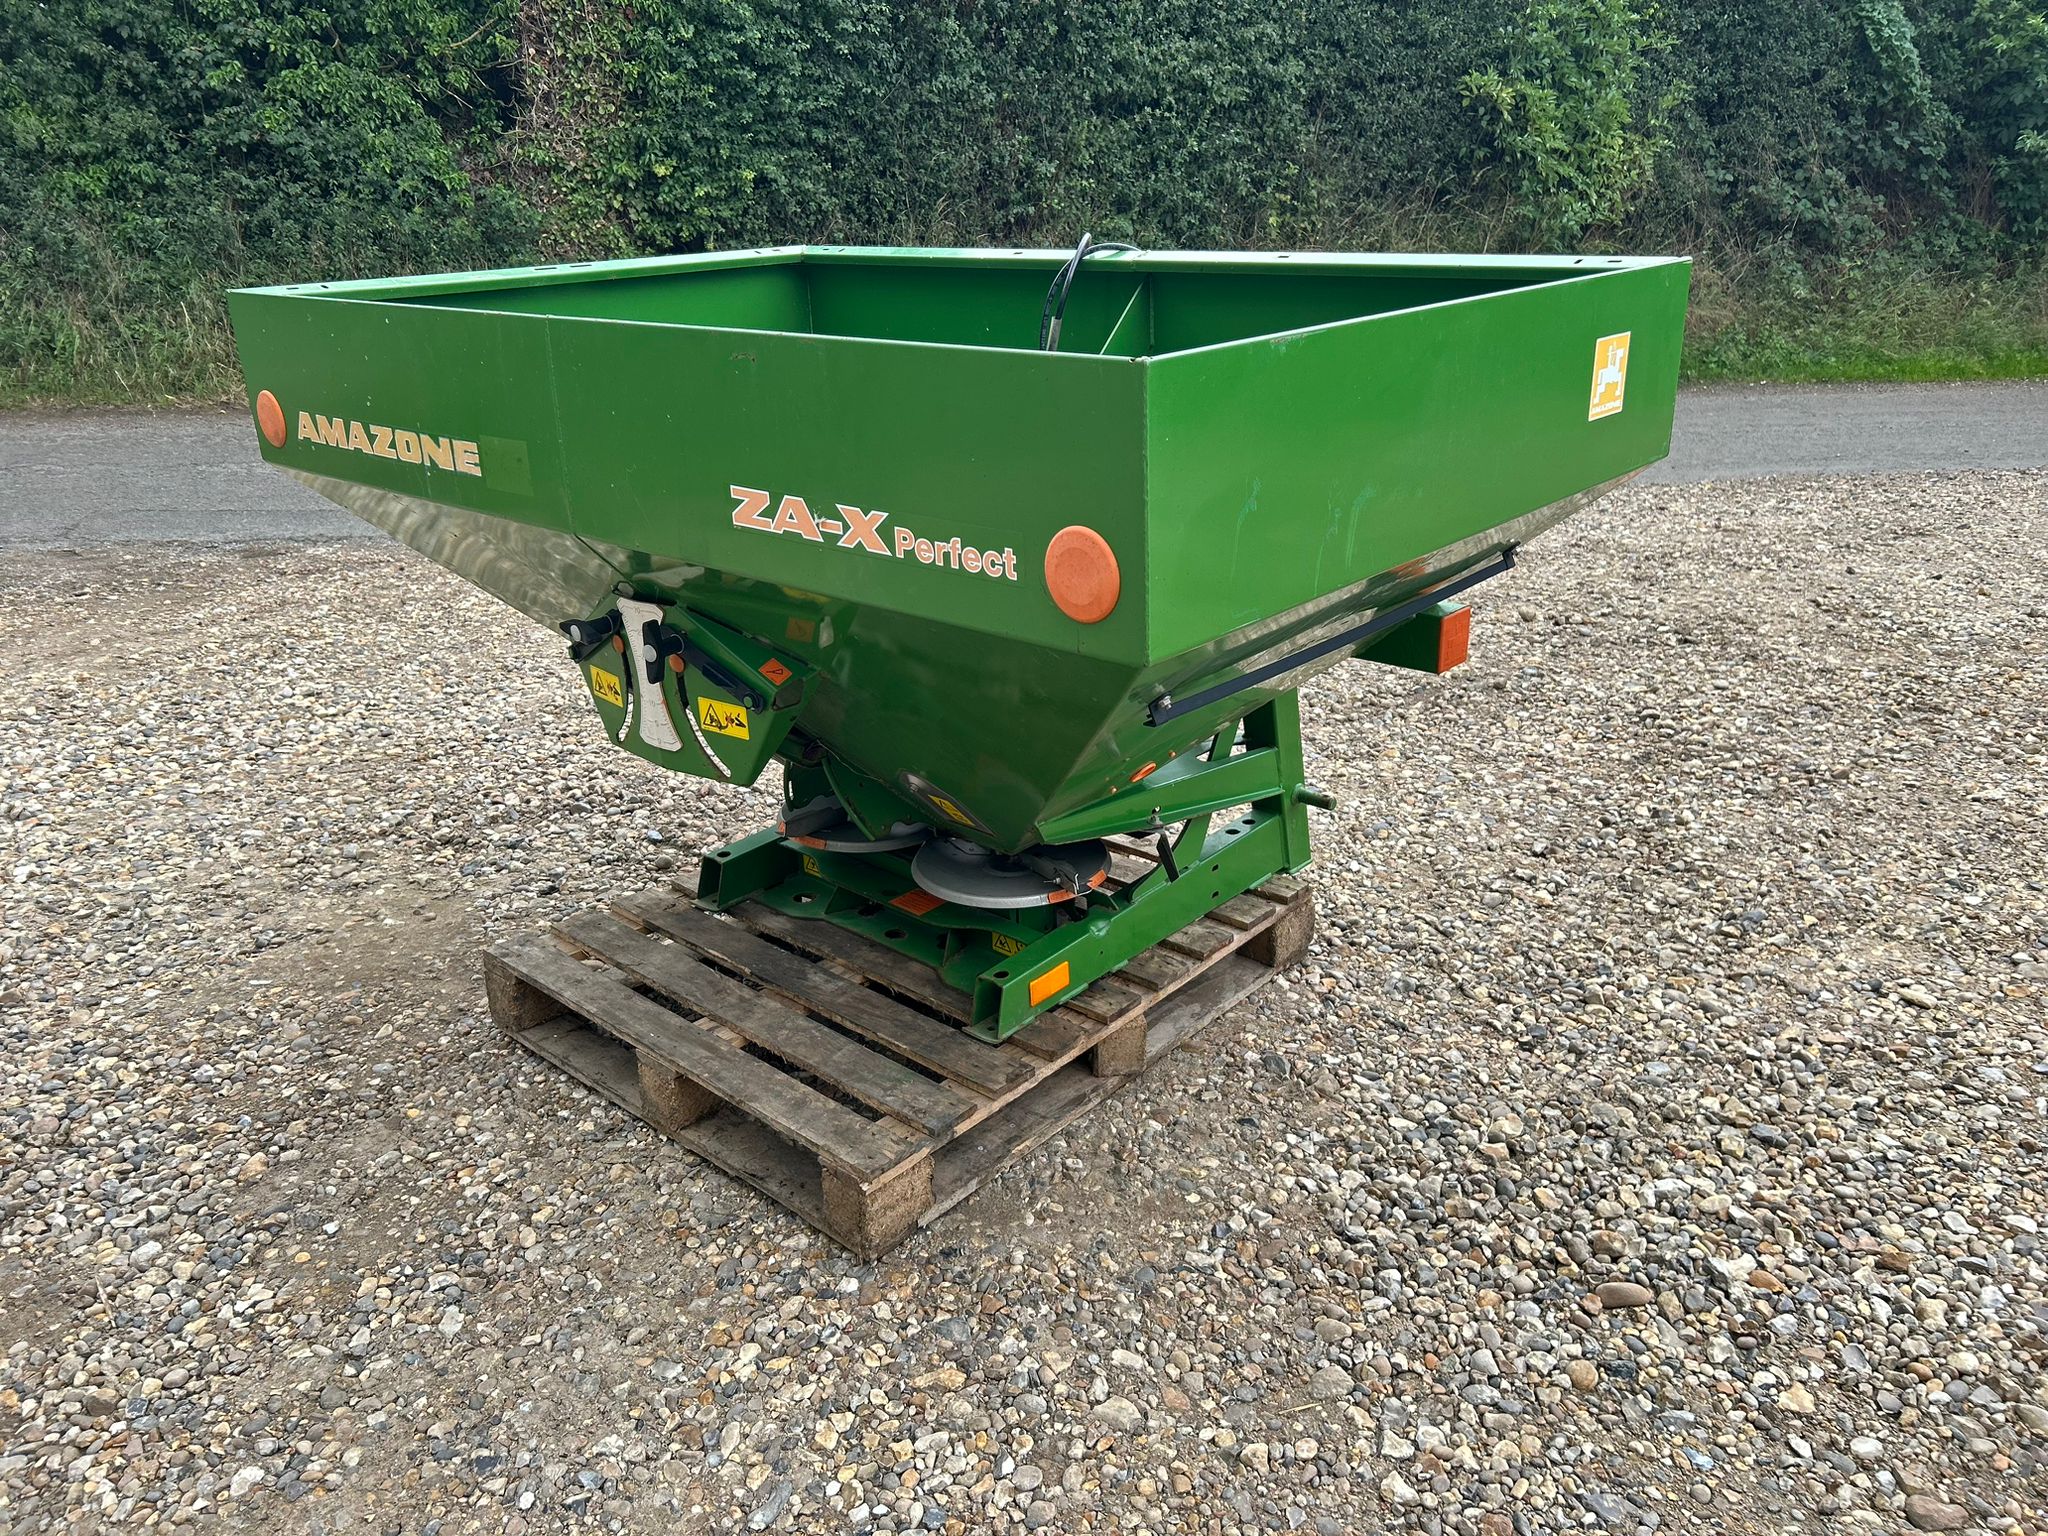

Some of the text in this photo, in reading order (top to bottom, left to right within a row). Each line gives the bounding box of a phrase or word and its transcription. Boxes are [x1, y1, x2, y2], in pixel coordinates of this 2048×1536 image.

[298, 411, 482, 477] AMAZONE
[730, 485, 1018, 581] ZA-X Perfect
